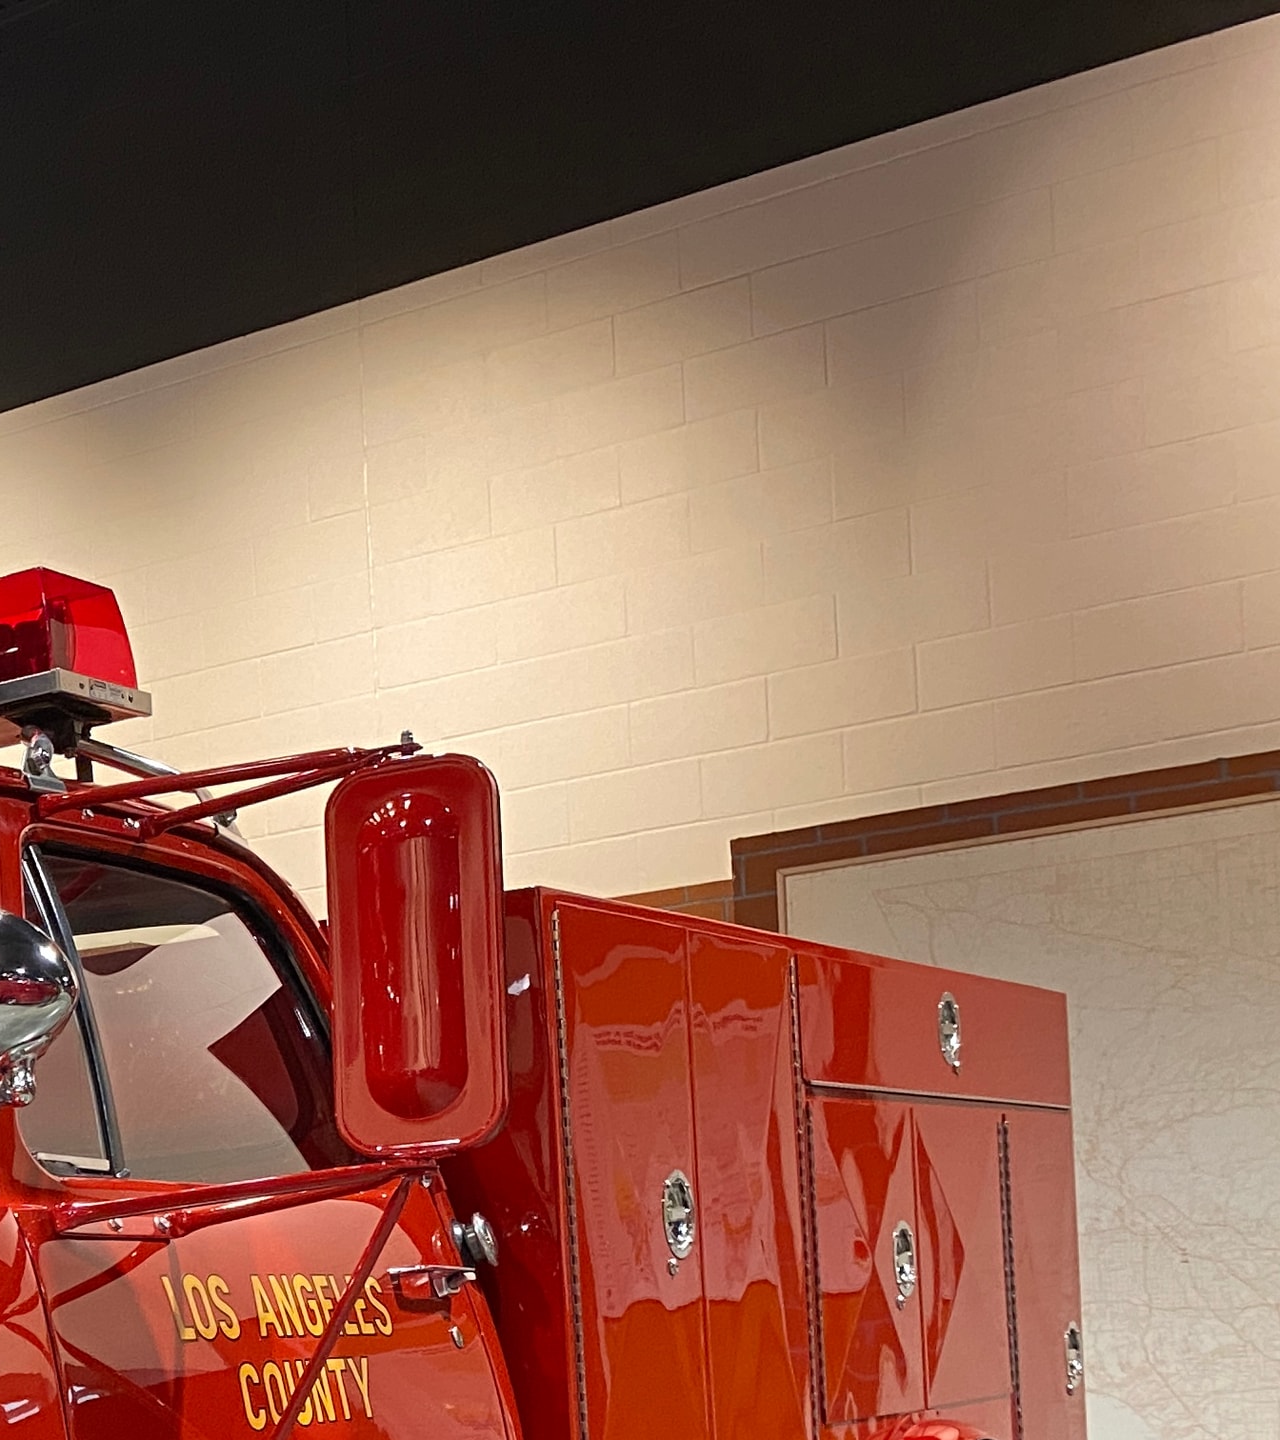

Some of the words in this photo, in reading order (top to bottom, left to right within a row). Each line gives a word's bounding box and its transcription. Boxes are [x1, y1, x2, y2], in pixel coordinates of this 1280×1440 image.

[160, 1273, 241, 1342] LOS
[250, 1273, 393, 1338] ANGELES
[239, 1356, 374, 1432] COUNTY
